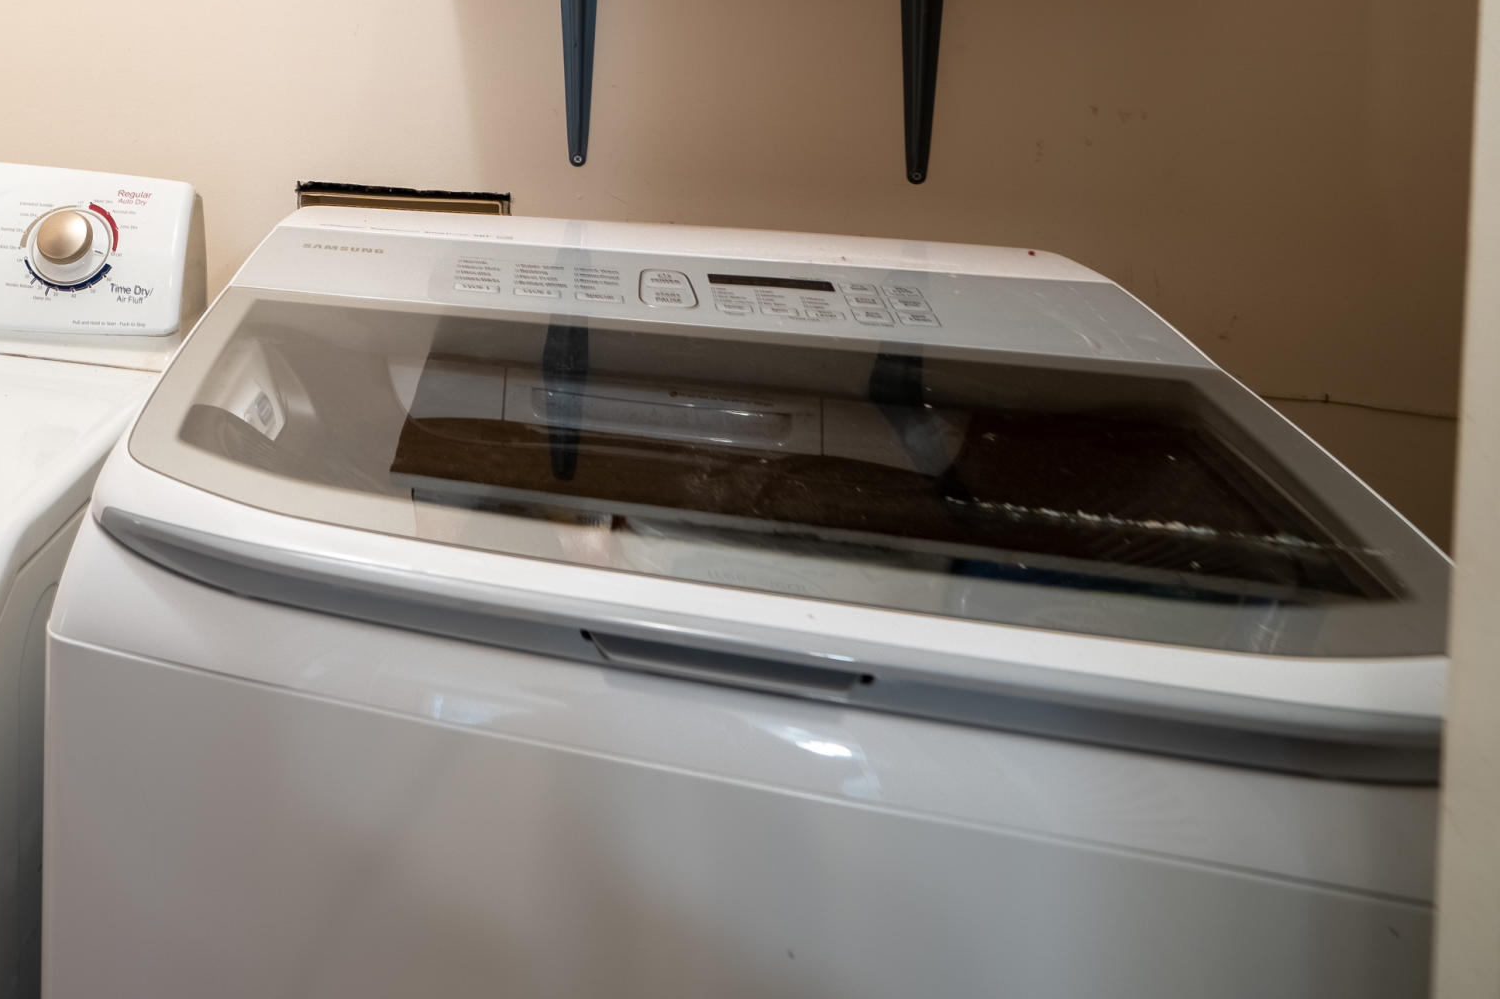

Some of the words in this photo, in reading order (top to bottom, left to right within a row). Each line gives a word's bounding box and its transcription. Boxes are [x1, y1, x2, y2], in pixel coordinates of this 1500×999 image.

[118, 189, 152, 199] Regular
[302, 243, 384, 254] SAMSUNG
[110, 283, 131, 294] Time
[134, 284, 154, 298] Dry/
[128, 296, 143, 304] Fluff
